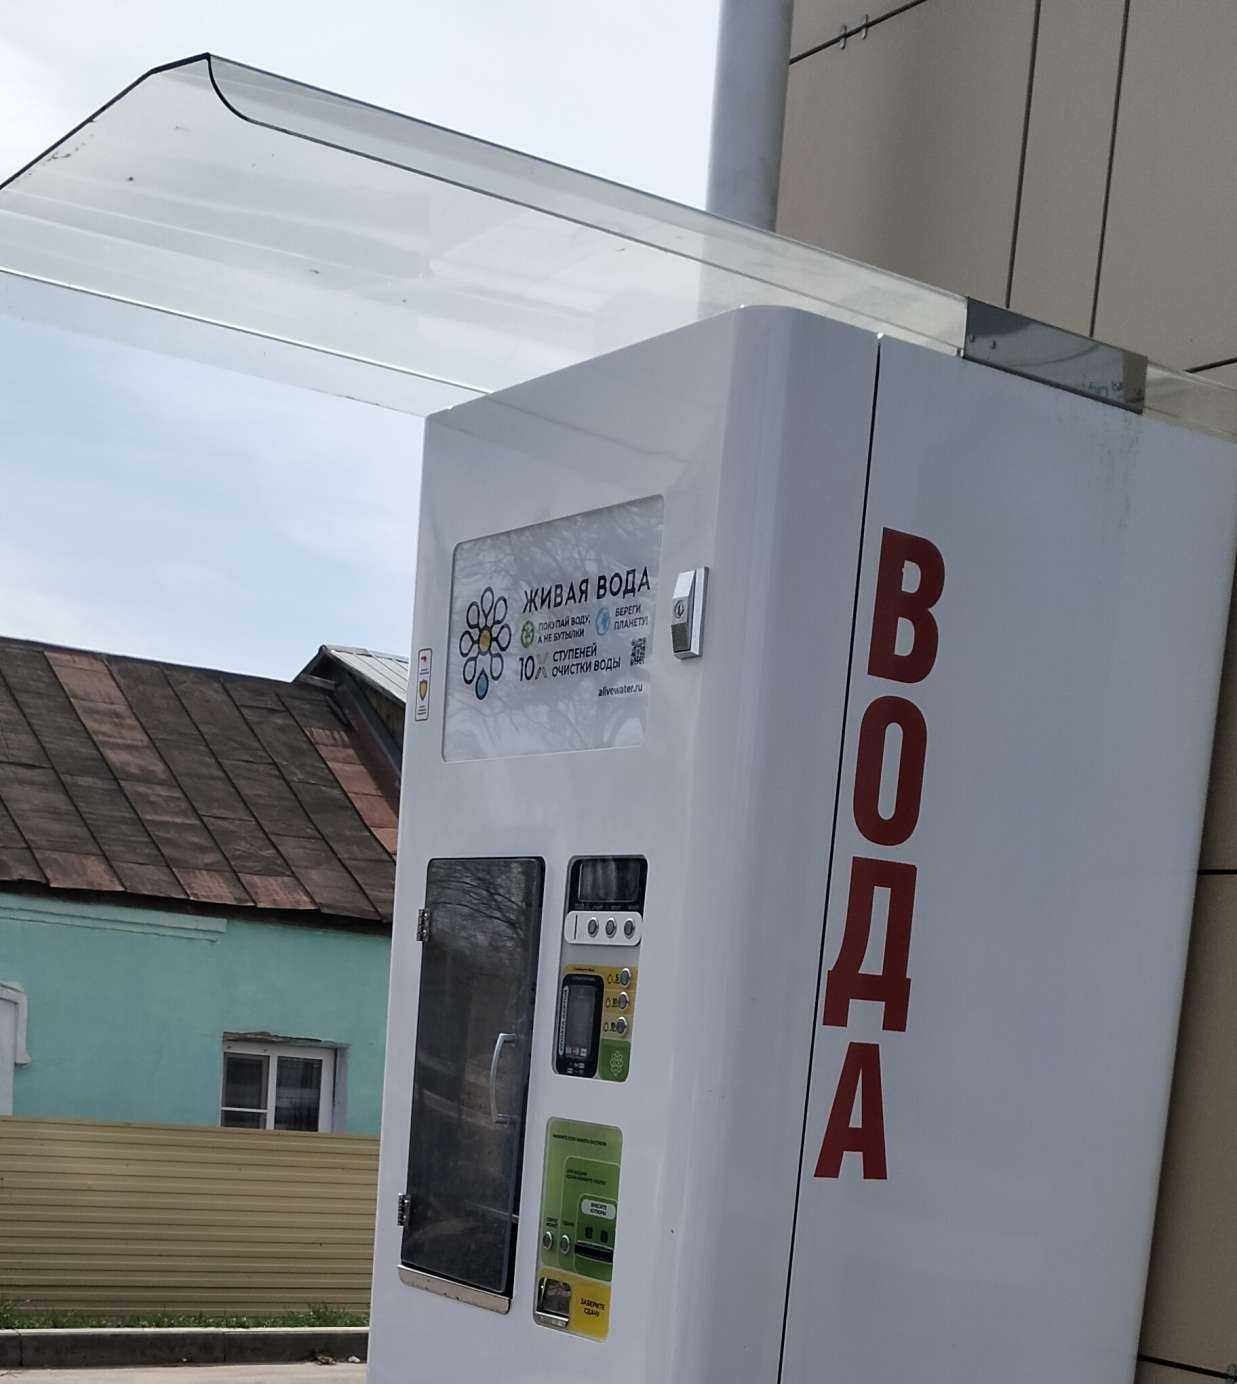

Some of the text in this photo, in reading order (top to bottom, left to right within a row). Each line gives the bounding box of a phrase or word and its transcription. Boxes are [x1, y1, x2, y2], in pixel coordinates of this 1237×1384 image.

[522, 565, 650, 614] ЖИВАЯ ВОДА
[615, 603, 641, 617] БЕРЕГИ
[538, 615, 570, 631] ПОКУПАЙ
[543, 633, 552, 643] НЕ
[553, 628, 585, 642] БУТЫЛКИ
[552, 642, 598, 662] СТУПЕНЕЙ
[551, 655, 621, 677] ОЧИСТКИ ВОДЫ
[598, 683, 643, 697] alivewater.ru
[814, 526, 946, 1181] ВОДА
